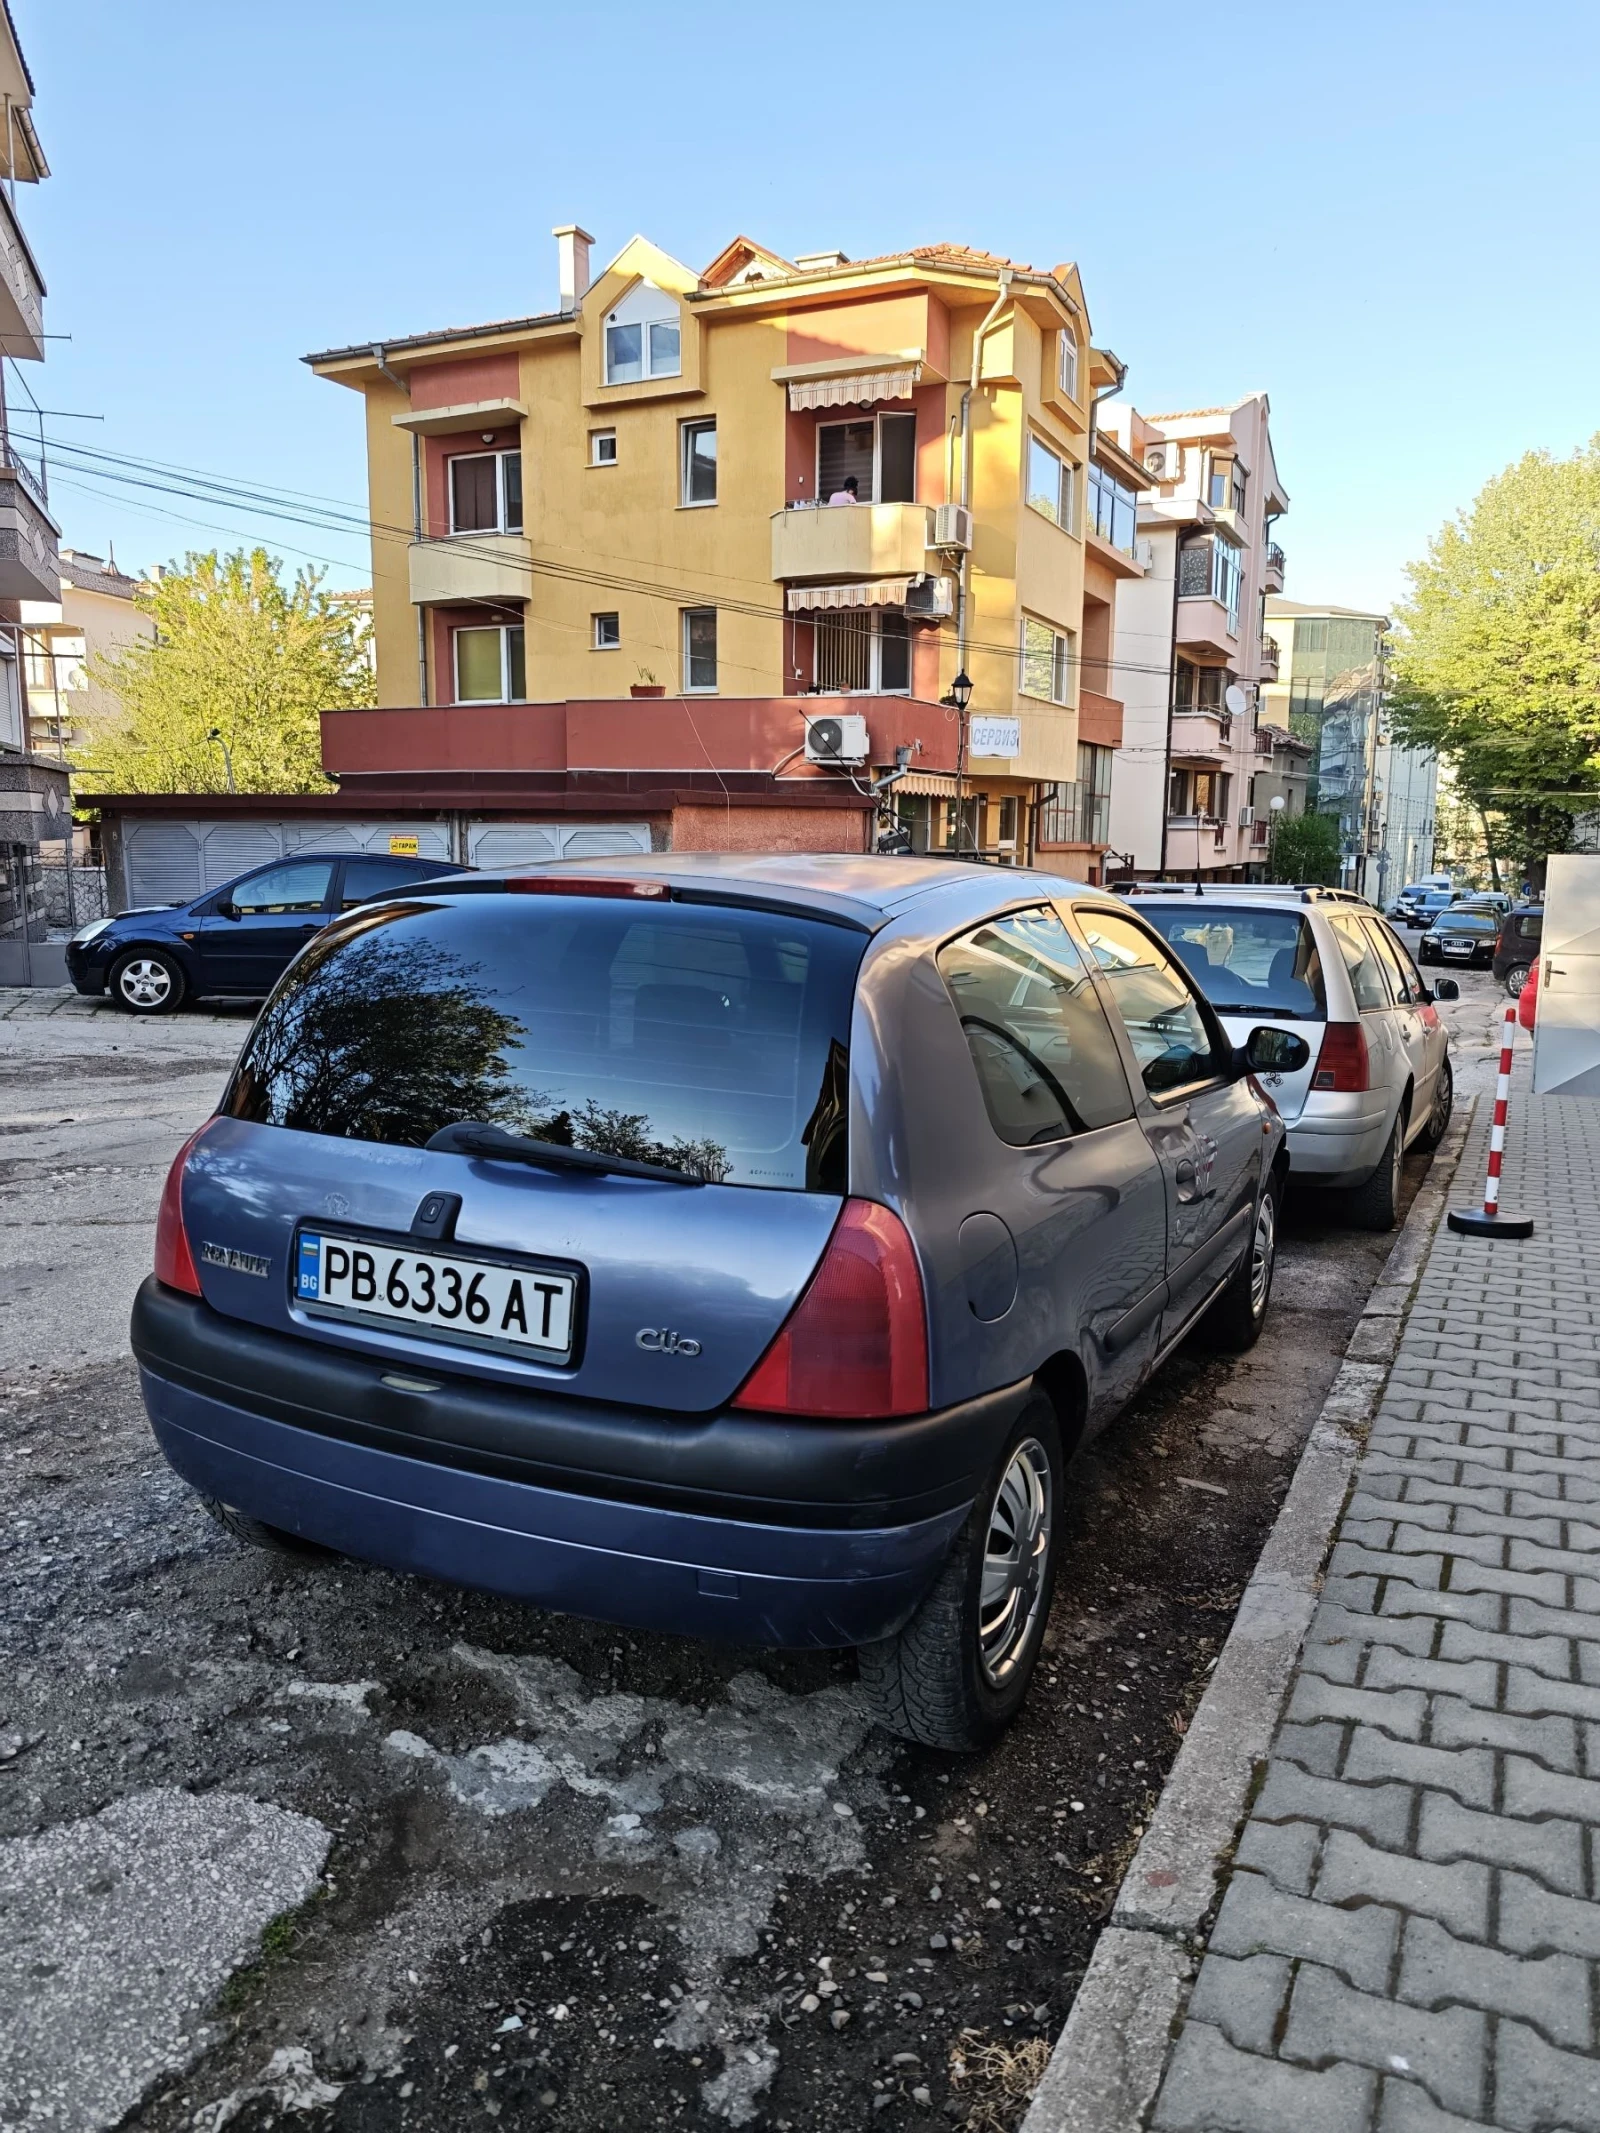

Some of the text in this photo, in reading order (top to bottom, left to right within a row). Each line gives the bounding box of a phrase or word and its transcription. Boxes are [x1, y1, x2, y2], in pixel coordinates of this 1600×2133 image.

[973, 728, 1018, 747] СЕРВИЗ
[201, 1240, 271, 1278] RENAULT
[301, 1274, 318, 1290] BG
[636, 1328, 702, 1357] Clio
